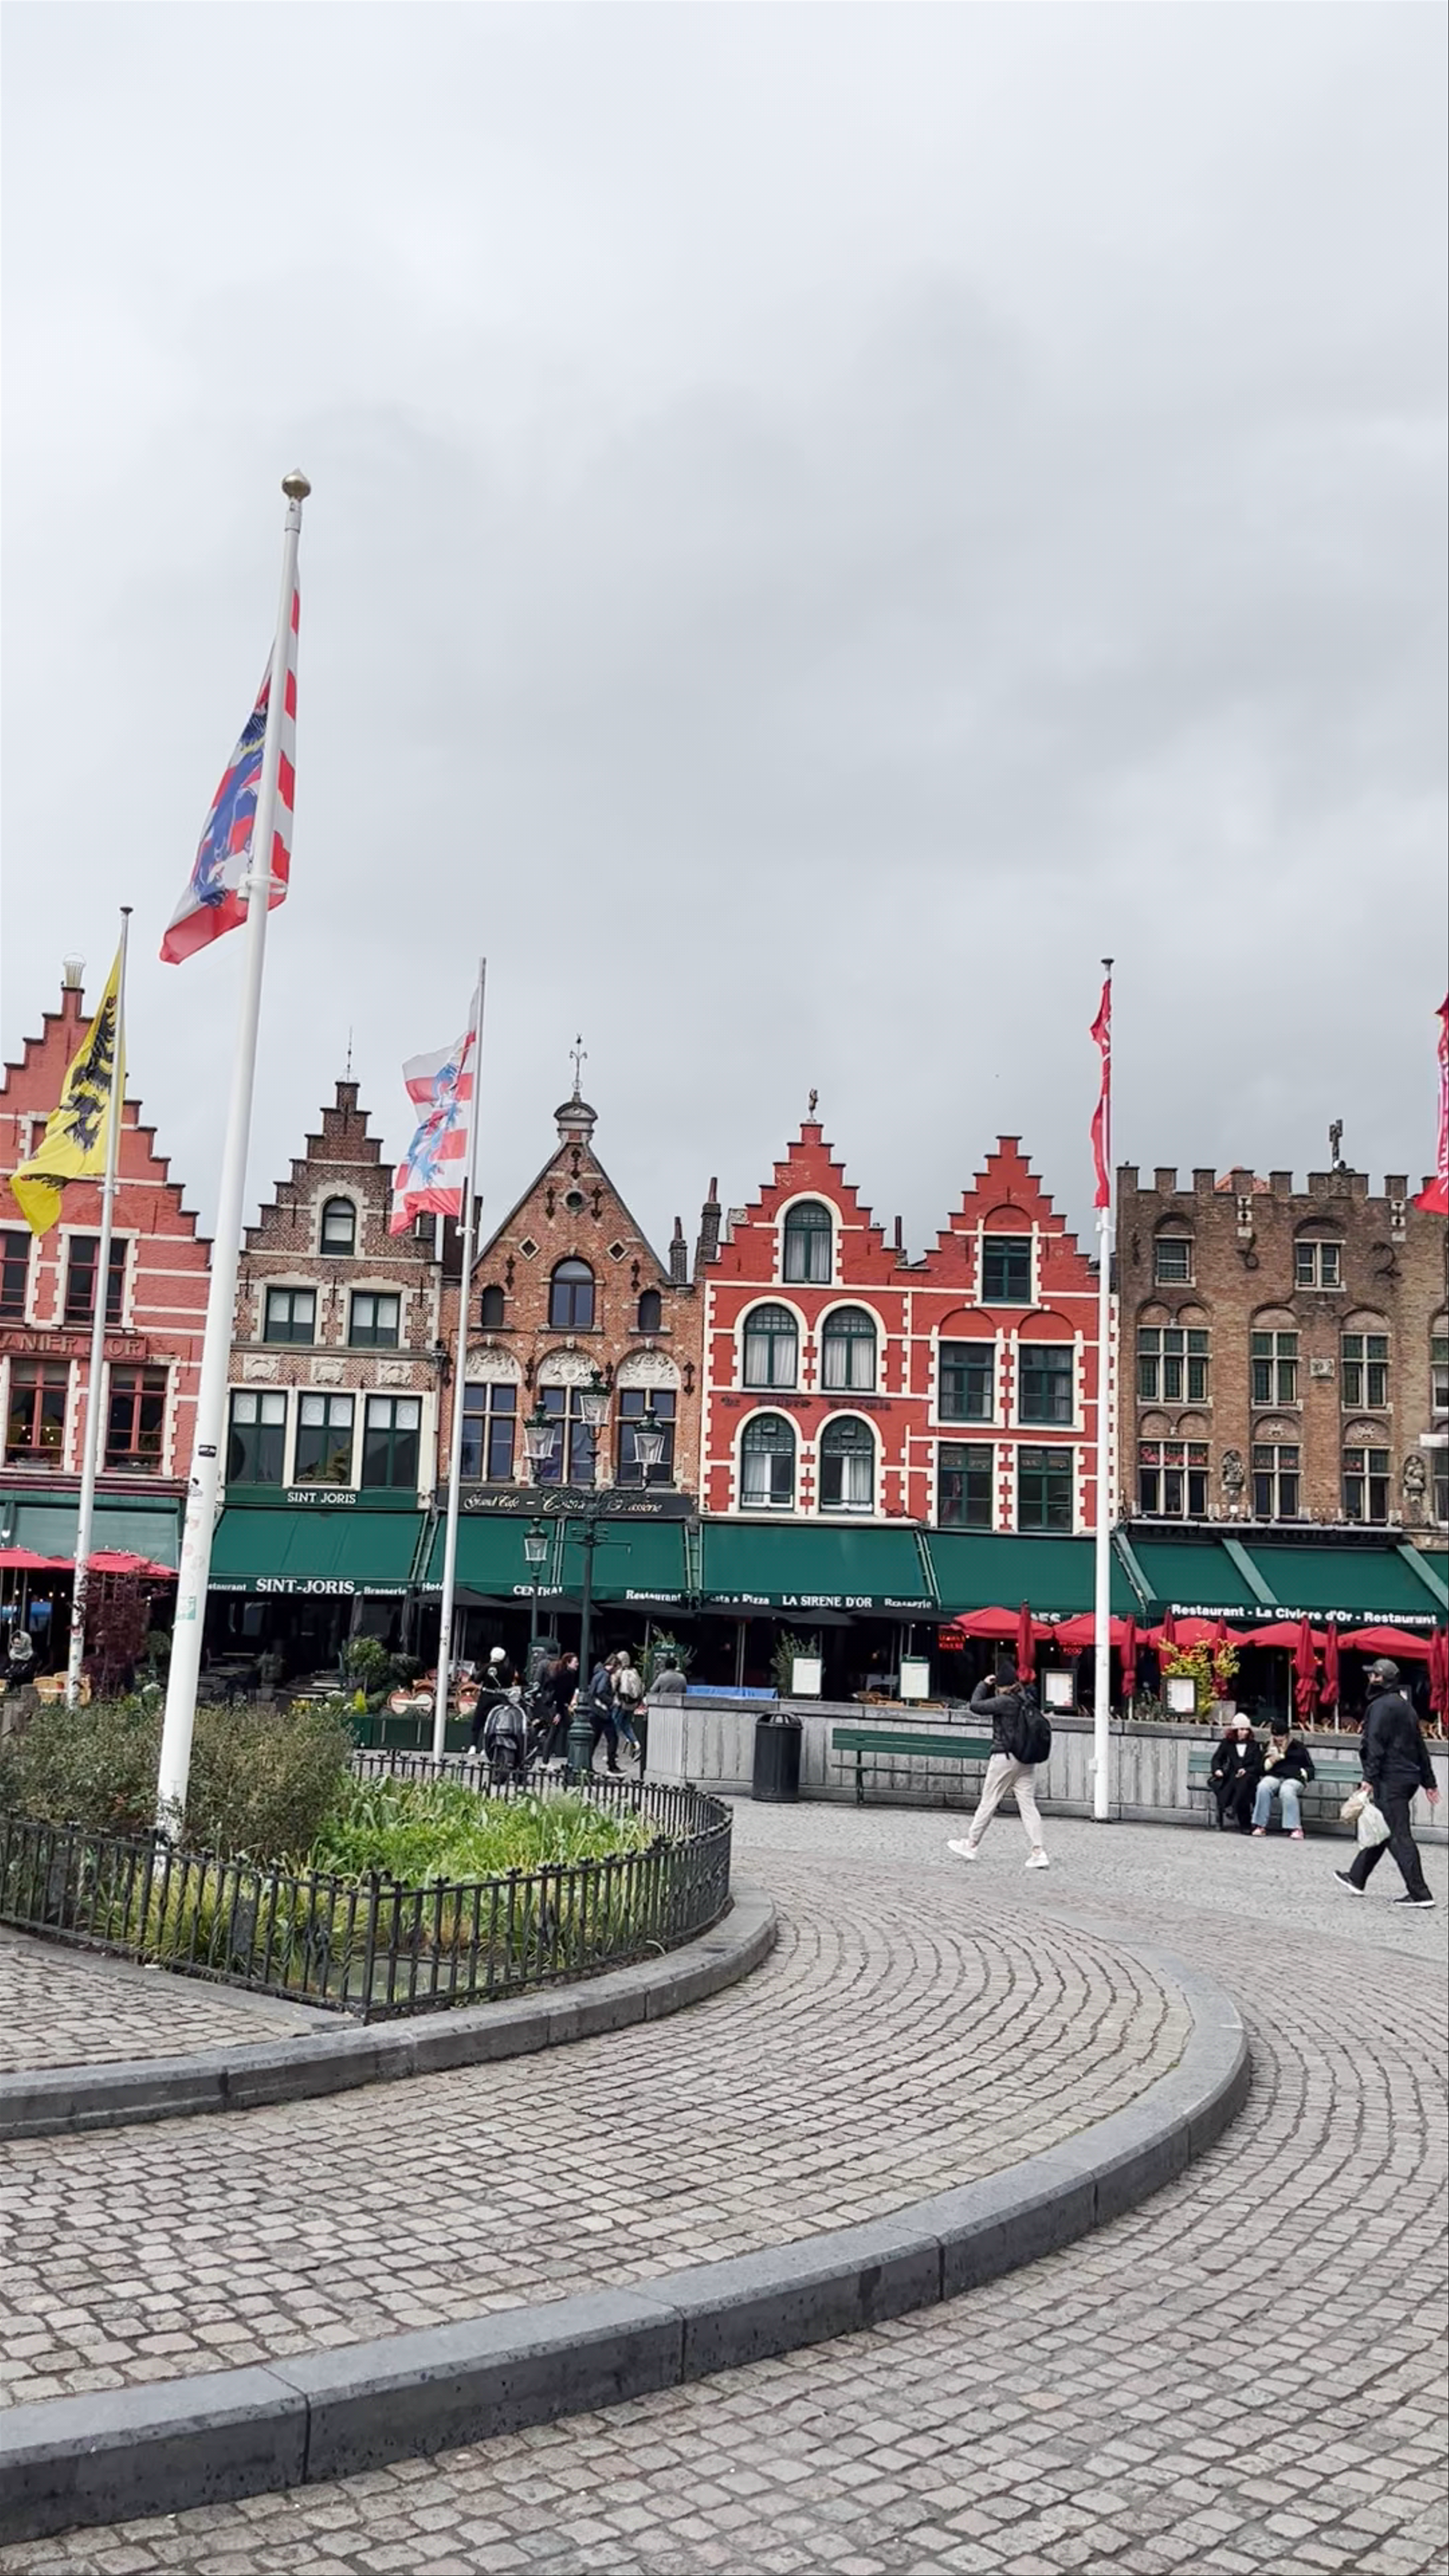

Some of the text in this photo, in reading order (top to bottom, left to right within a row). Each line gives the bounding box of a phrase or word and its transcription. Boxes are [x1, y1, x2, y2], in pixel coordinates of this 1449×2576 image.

[288, 1492, 356, 1504] SINT JORIS
[256, 1578, 355, 1594] SINT-JORIS
[364, 1586, 407, 1595] Brasserie
[742, 1593, 770, 1605] Pizza
[782, 1595, 872, 1608] LA SIRENE D'OR
[1171, 1604, 1245, 1616] Restaurant
[1256, 1607, 1272, 1618] La
[1324, 1610, 1353, 1621] d'Or
[1364, 1612, 1438, 1624] Restaurant
